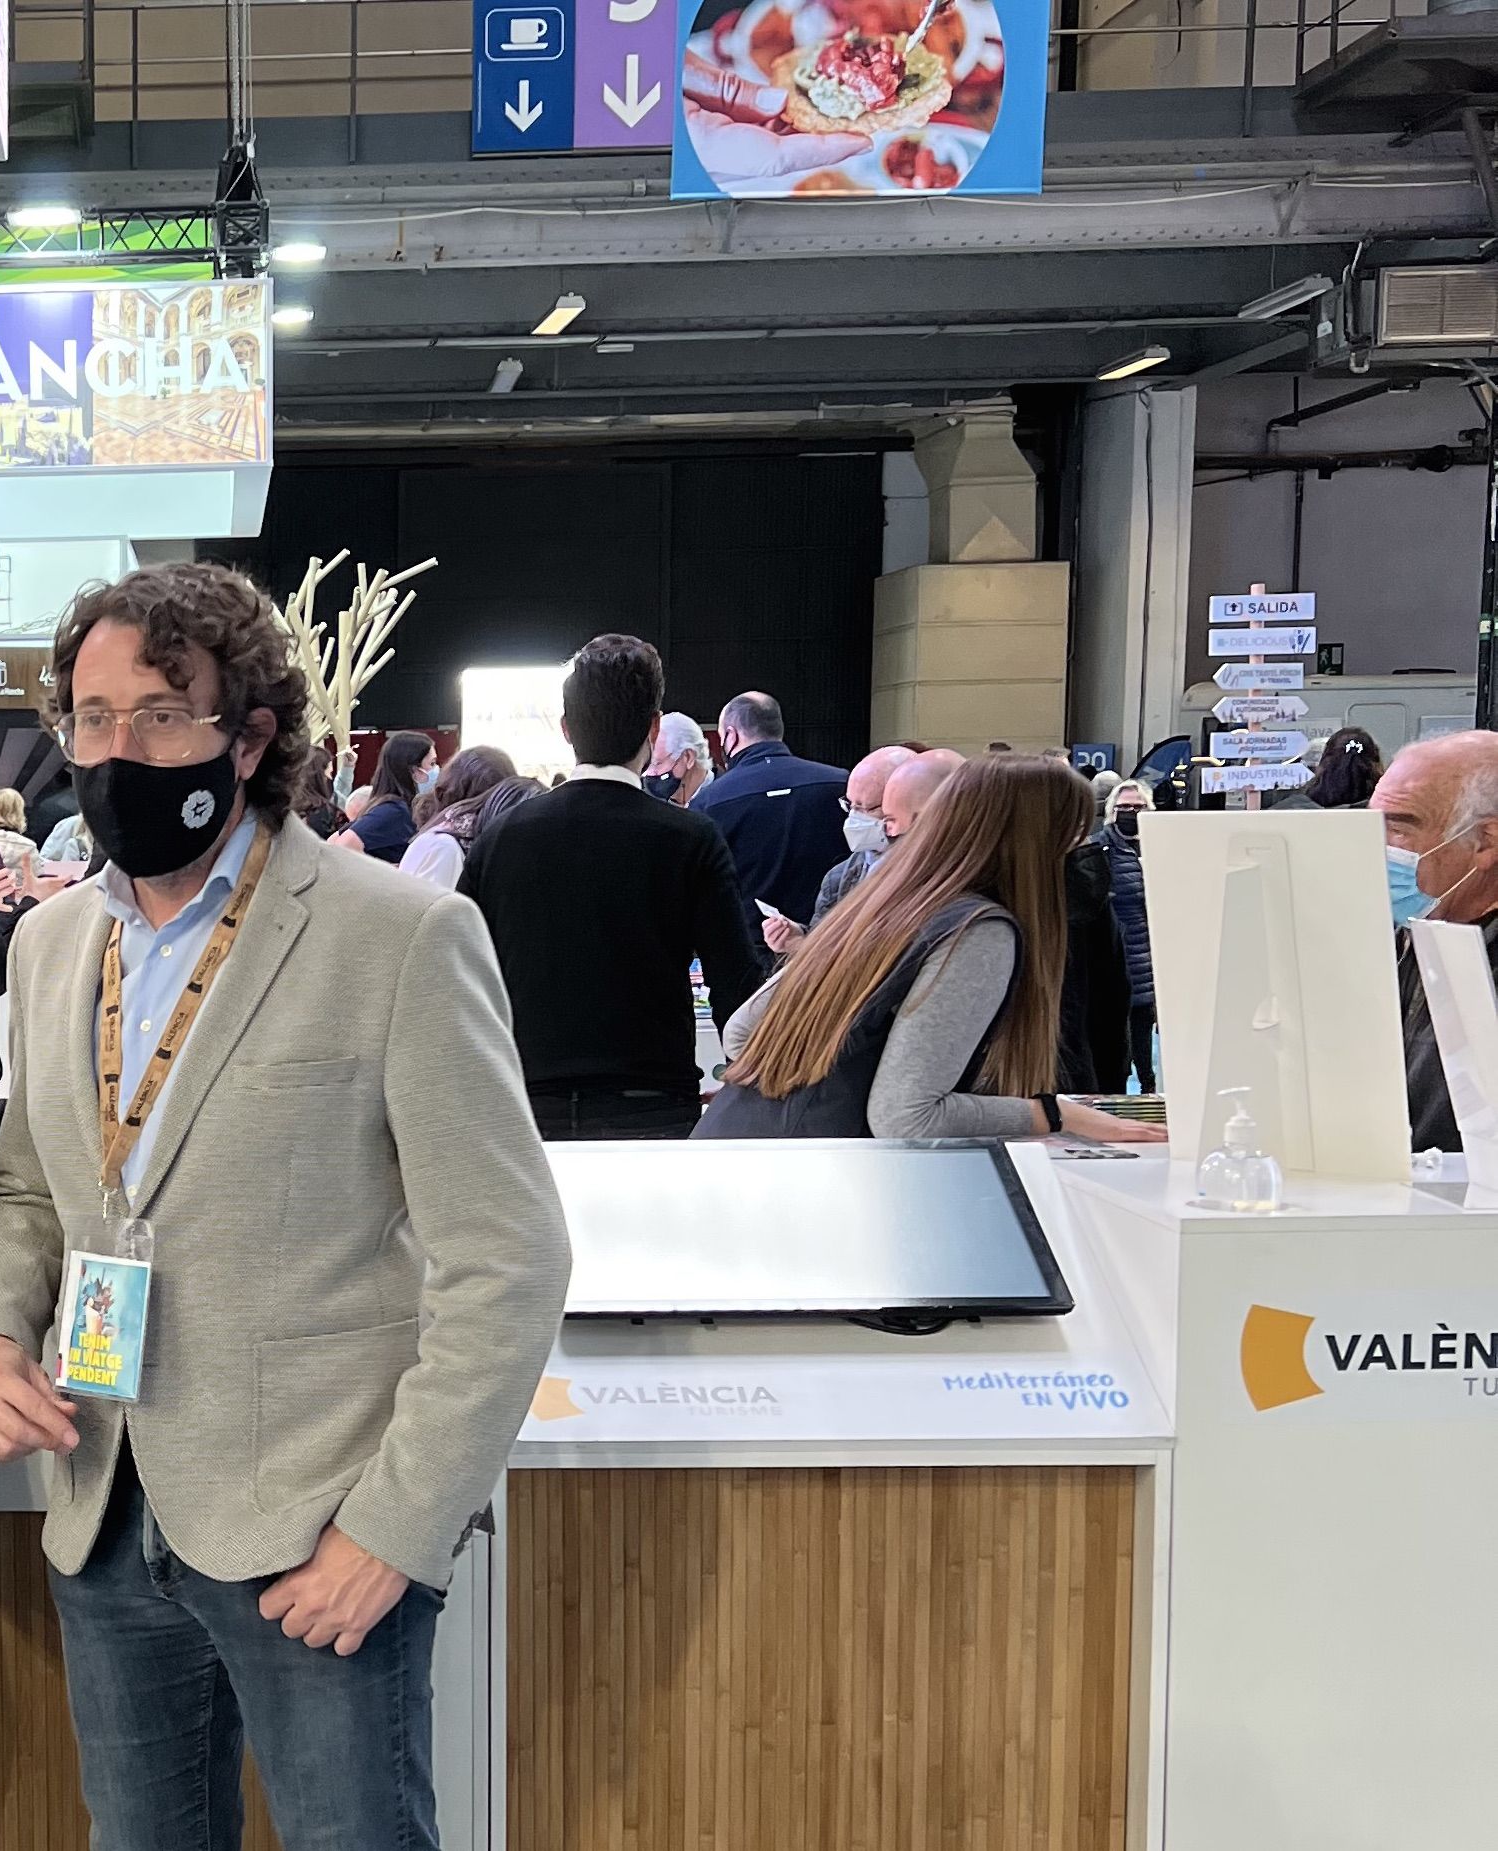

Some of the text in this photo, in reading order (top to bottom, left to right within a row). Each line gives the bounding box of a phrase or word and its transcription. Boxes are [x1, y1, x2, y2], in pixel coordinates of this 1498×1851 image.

[1248, 602, 1299, 614] SALIDA
[1230, 637, 1289, 647] DELICIOUS
[1222, 737, 1287, 745] SALA JORNADAS
[1227, 768, 1296, 780] INDUSTRIAL
[943, 1372, 1114, 1391] Mediterráneo
[582, 1382, 778, 1404] VALÈNCIA
[1021, 1392, 1053, 1407] EN
[689, 1406, 783, 1417] TURISME
